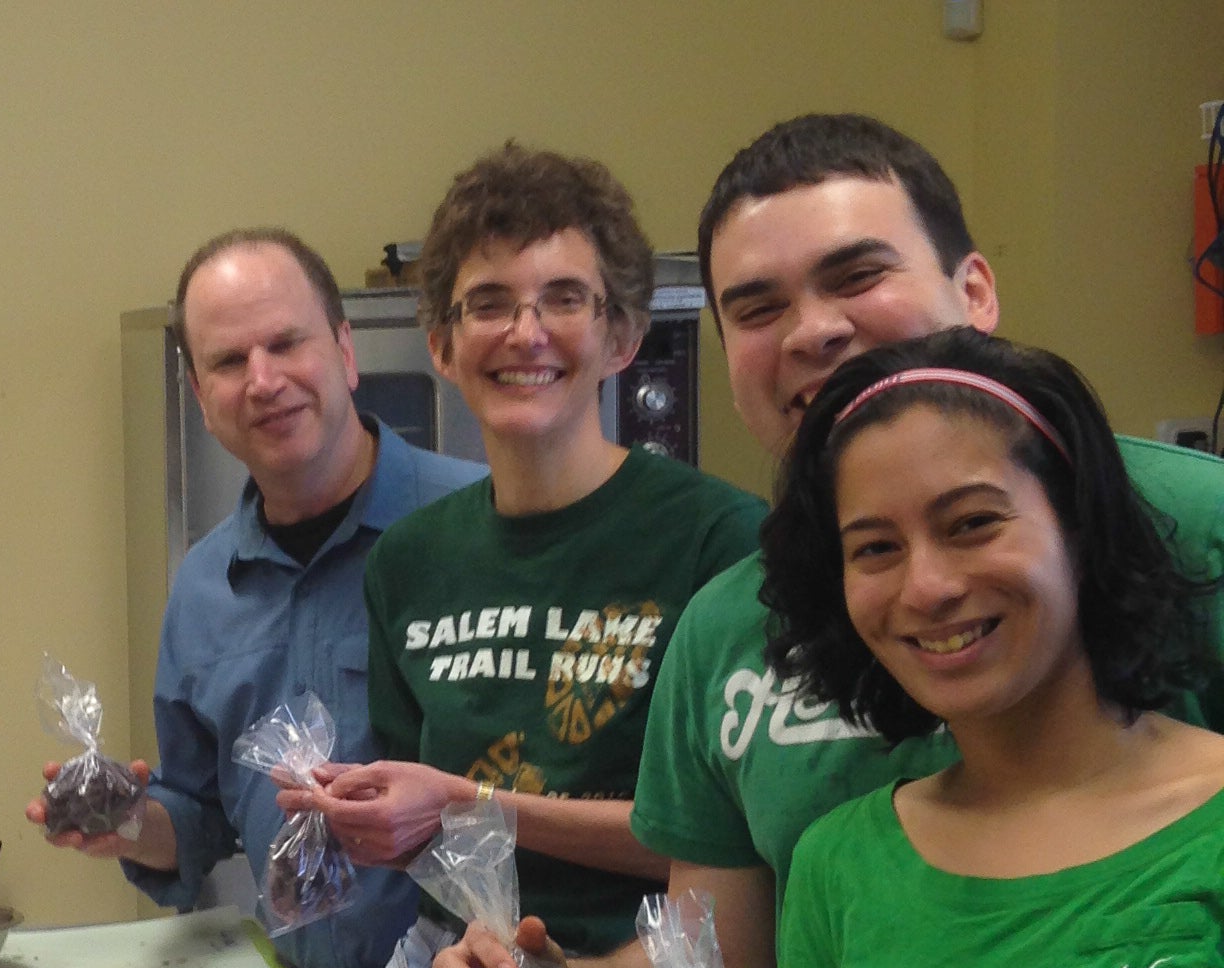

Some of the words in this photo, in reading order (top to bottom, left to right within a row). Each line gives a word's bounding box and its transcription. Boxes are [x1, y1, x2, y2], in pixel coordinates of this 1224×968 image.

[404, 605, 533, 651] SALEM
[544, 605, 664, 648] LAKE
[428, 647, 537, 682] TRAIL
[549, 652, 652, 689] RUNS
